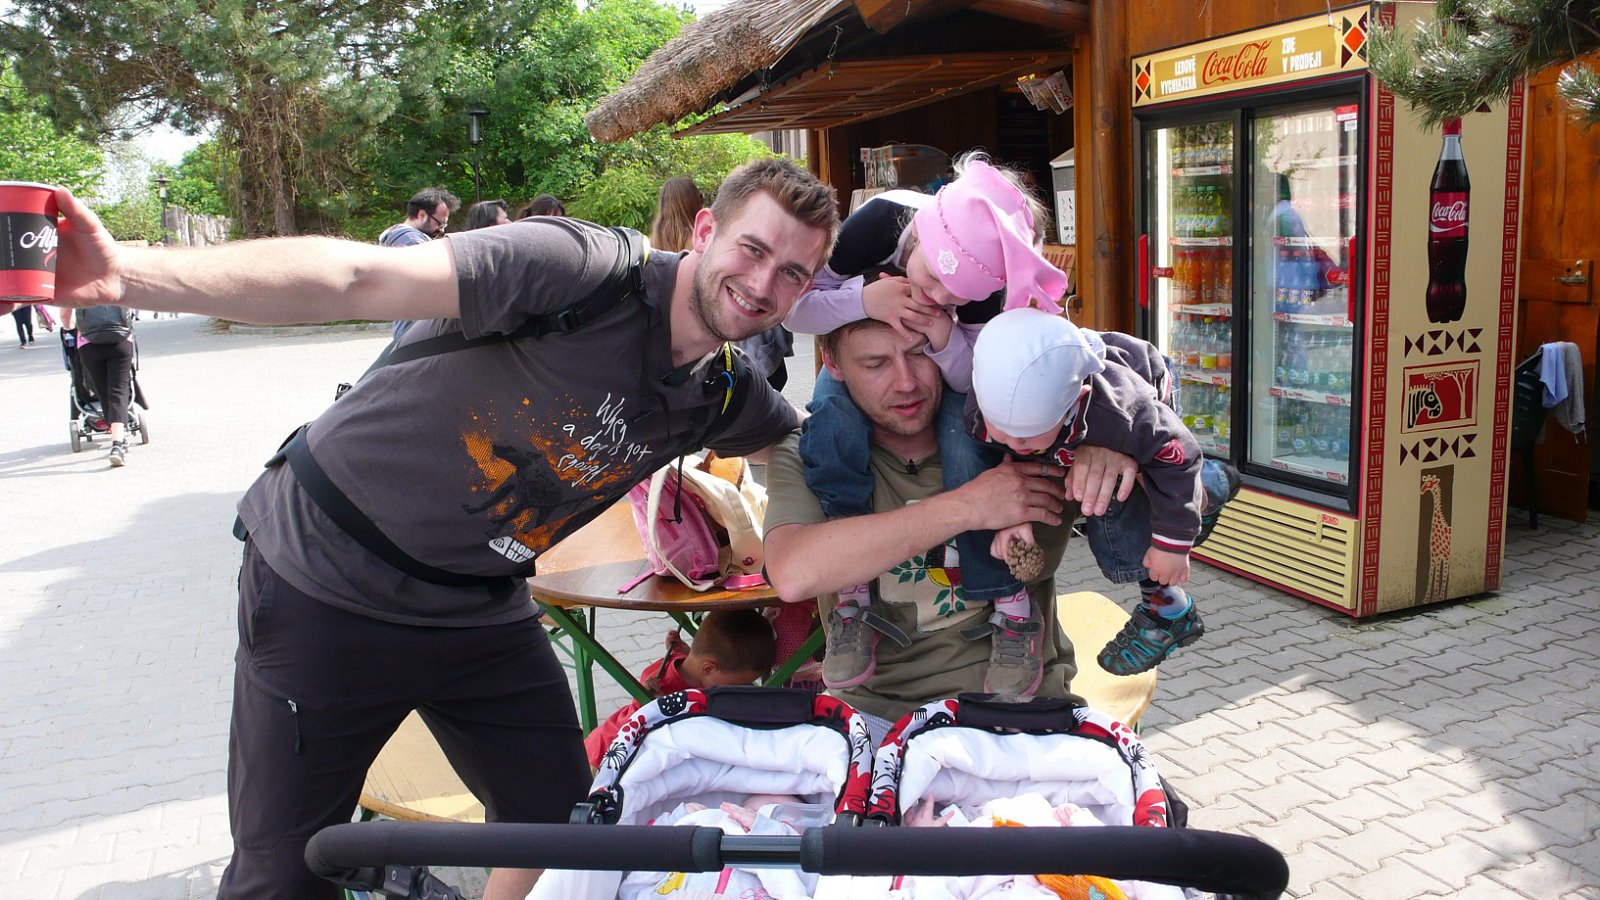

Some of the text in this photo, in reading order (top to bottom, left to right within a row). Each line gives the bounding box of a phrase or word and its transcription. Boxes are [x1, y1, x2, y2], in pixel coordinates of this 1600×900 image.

[1281, 36, 1296, 55] ZDE
[1202, 40, 1272, 85] Coca-Cola
[1282, 50, 1322, 74] V PRODEJI
[1431, 200, 1467, 222] Coca-Cola
